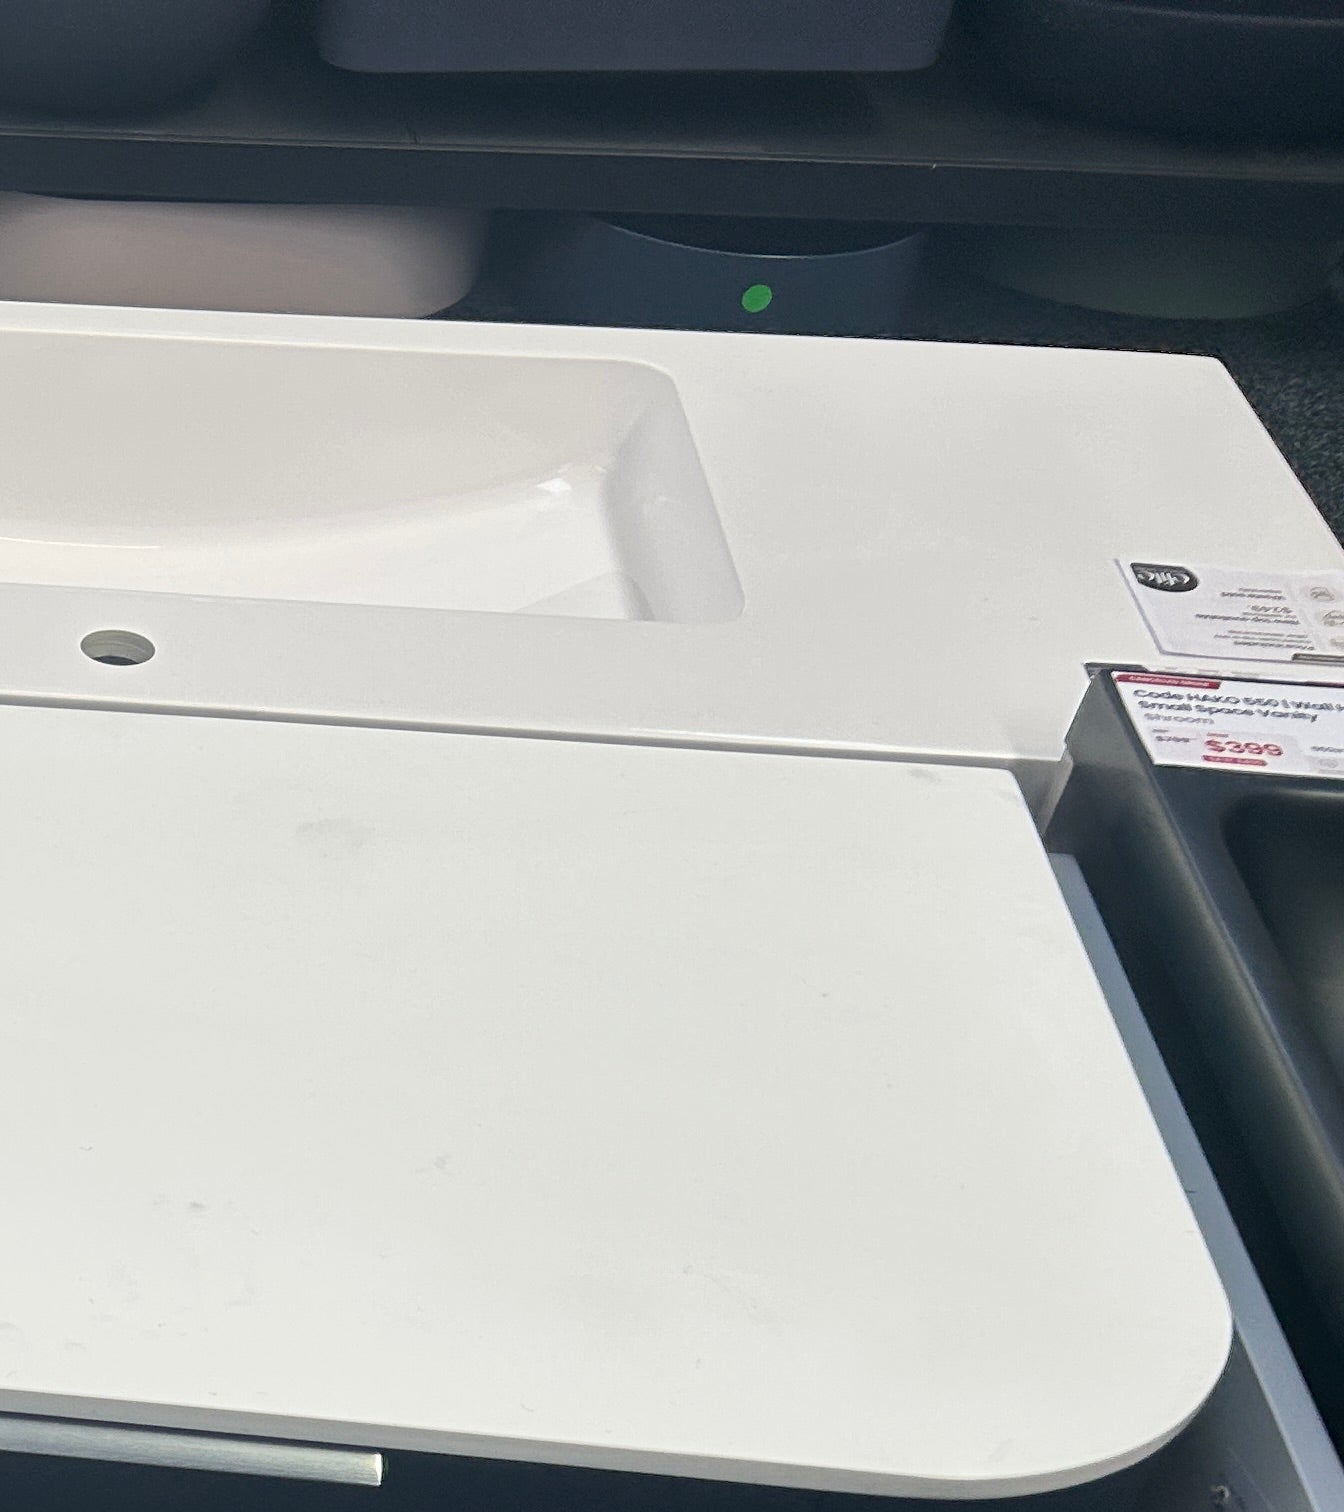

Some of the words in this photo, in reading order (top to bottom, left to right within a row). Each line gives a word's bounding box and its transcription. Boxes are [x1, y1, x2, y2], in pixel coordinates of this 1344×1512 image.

[1132, 689, 1185, 701] Code
[1137, 700, 1193, 712] Small
[1194, 704, 1255, 716] Space
[1256, 708, 1318, 723] Vanity
[1204, 739, 1284, 757] $399
